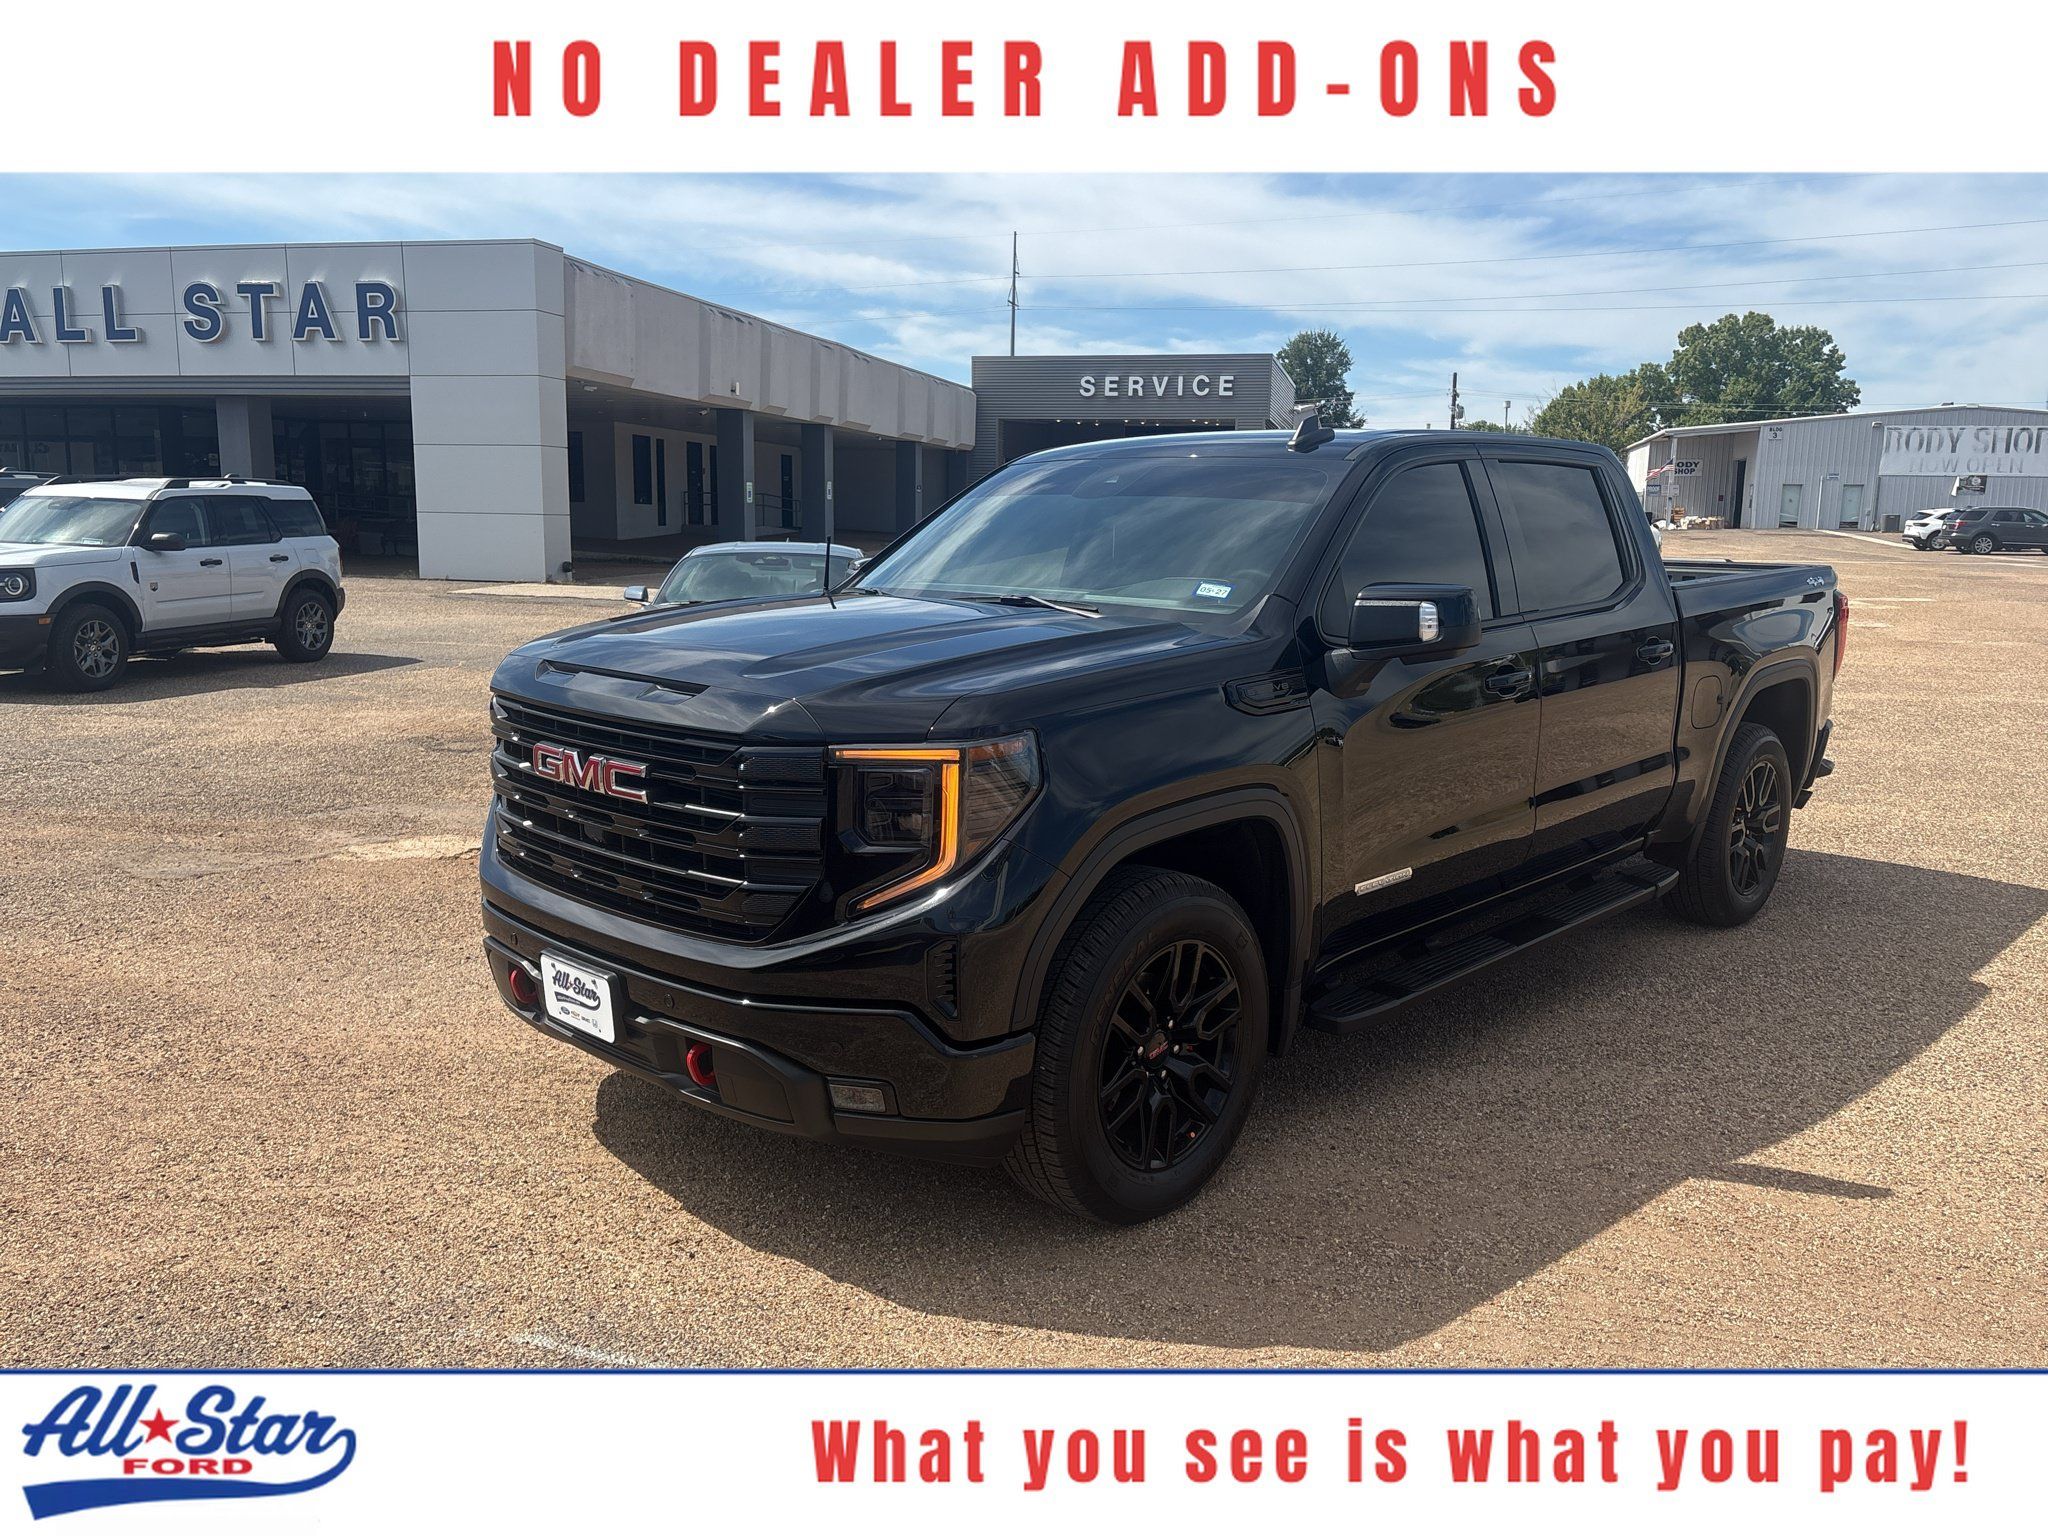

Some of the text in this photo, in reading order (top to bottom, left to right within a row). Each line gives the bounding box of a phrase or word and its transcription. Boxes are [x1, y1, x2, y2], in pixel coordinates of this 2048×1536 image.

[0, 281, 401, 343] ALL STAR
[1079, 375, 1234, 397] SERVICE
[1885, 426, 1967, 454] BODY
[1908, 455, 2024, 474] NOW OPEN
[532, 742, 649, 805] GMC
